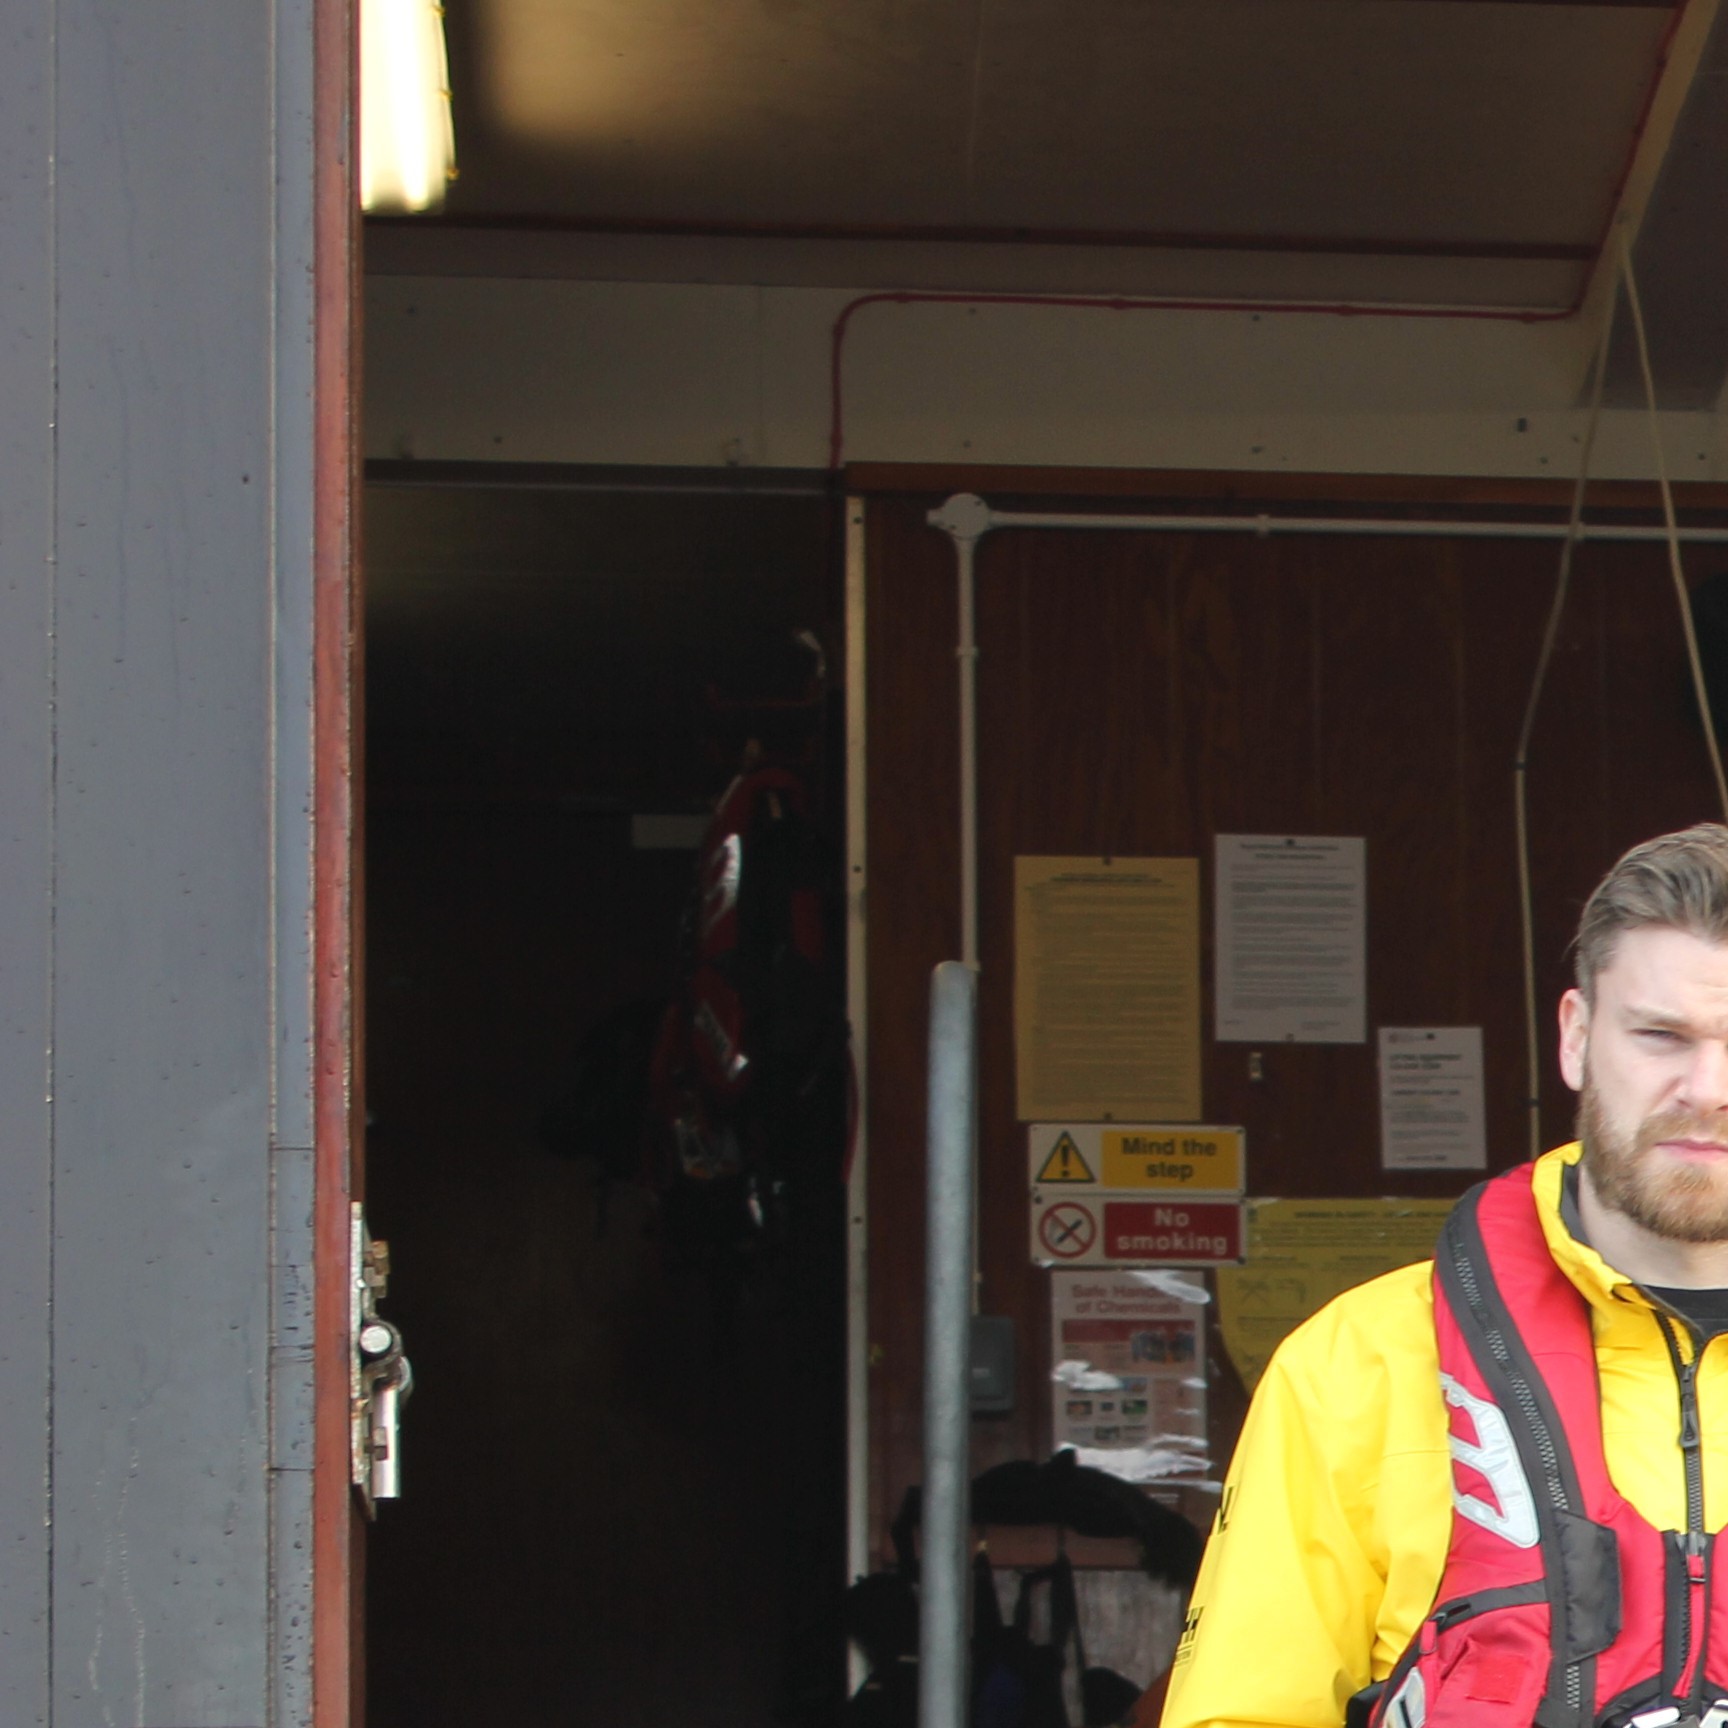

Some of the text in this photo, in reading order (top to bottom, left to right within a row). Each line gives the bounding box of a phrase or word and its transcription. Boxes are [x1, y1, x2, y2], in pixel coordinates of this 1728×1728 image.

[1121, 1137, 1217, 1157] Mind the
[1145, 1162, 1194, 1182] step
[1154, 1208, 1190, 1227] No
[1117, 1233, 1228, 1256] smoking
